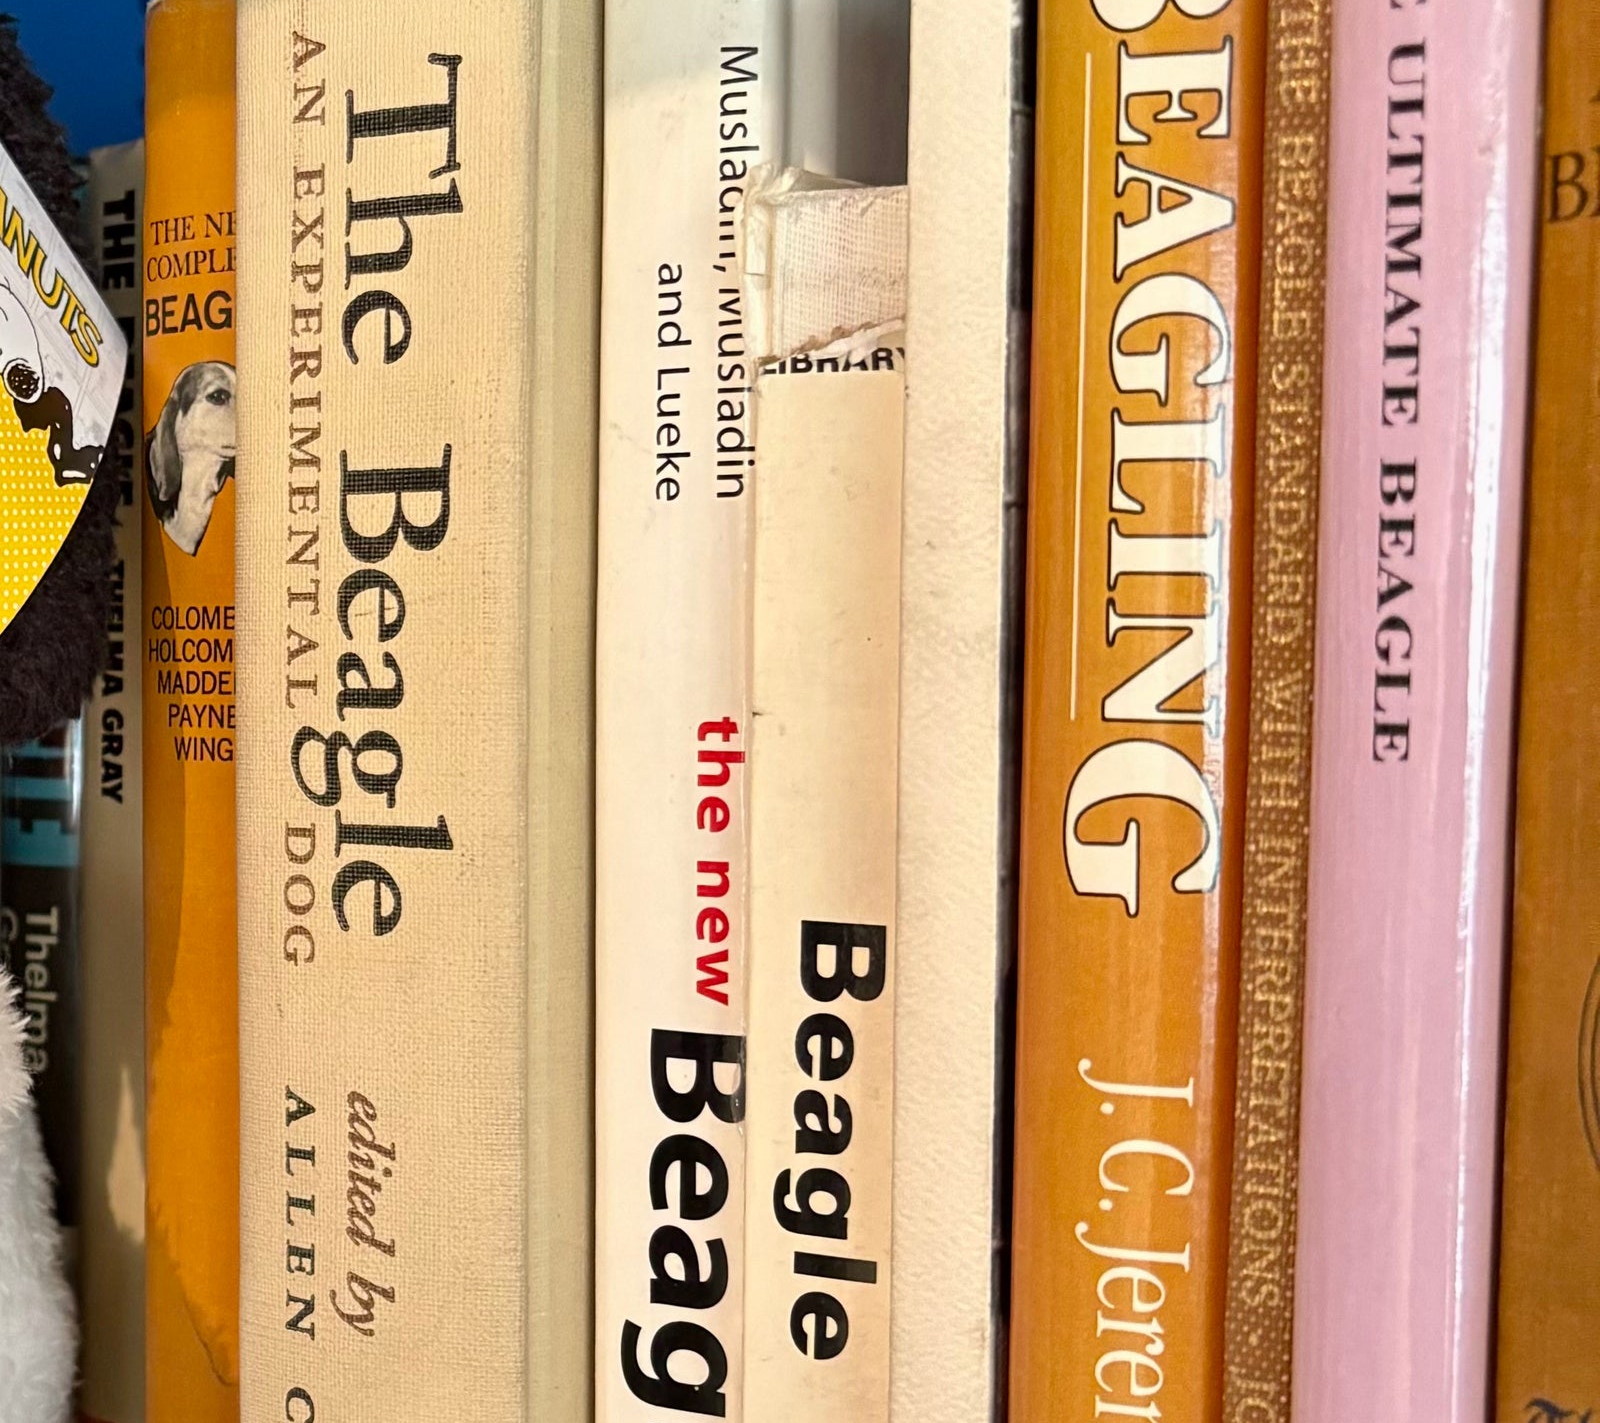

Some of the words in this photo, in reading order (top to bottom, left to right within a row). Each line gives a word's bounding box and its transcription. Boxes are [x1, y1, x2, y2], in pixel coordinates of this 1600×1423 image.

[290, 30, 326, 126] AN
[103, 189, 136, 289] THE
[150, 215, 196, 246] THE
[341, 52, 464, 365] The
[1273, 135, 1318, 338] BEAGLE
[1382, 37, 1426, 428] ULTIMATE
[145, 290, 232, 337] BEAG
[657, 263, 692, 348] and
[284, 163, 326, 709] EXPERIMENTAL
[655, 367, 691, 501] Lueke
[1265, 363, 1311, 644] STANDARD
[149, 638, 233, 663] HOLCOM
[1372, 456, 1417, 763] BEAGLE
[158, 670, 236, 695] MADDE
[168, 704, 236, 729] PAYNE
[174, 736, 234, 762] WING
[291, 443, 454, 936] Beagle
[1261, 668, 1303, 808] WITH
[102, 708, 124, 804] GRAY
[696, 716, 746, 833] the
[283, 822, 316, 966] DOG
[694, 859, 731, 1007] new
[23, 906, 60, 1072] Thelma
[1078, 1057, 1196, 1117] J.
[1240, 833, 1297, 1307] INTERPRETATIONS
[346, 1090, 396, 1257] edited
[773, 919, 887, 1362] Beagle
[1097, 1139, 1196, 1212] C.
[284, 1085, 316, 1340] ALLEN
[330, 1270, 396, 1337] by
